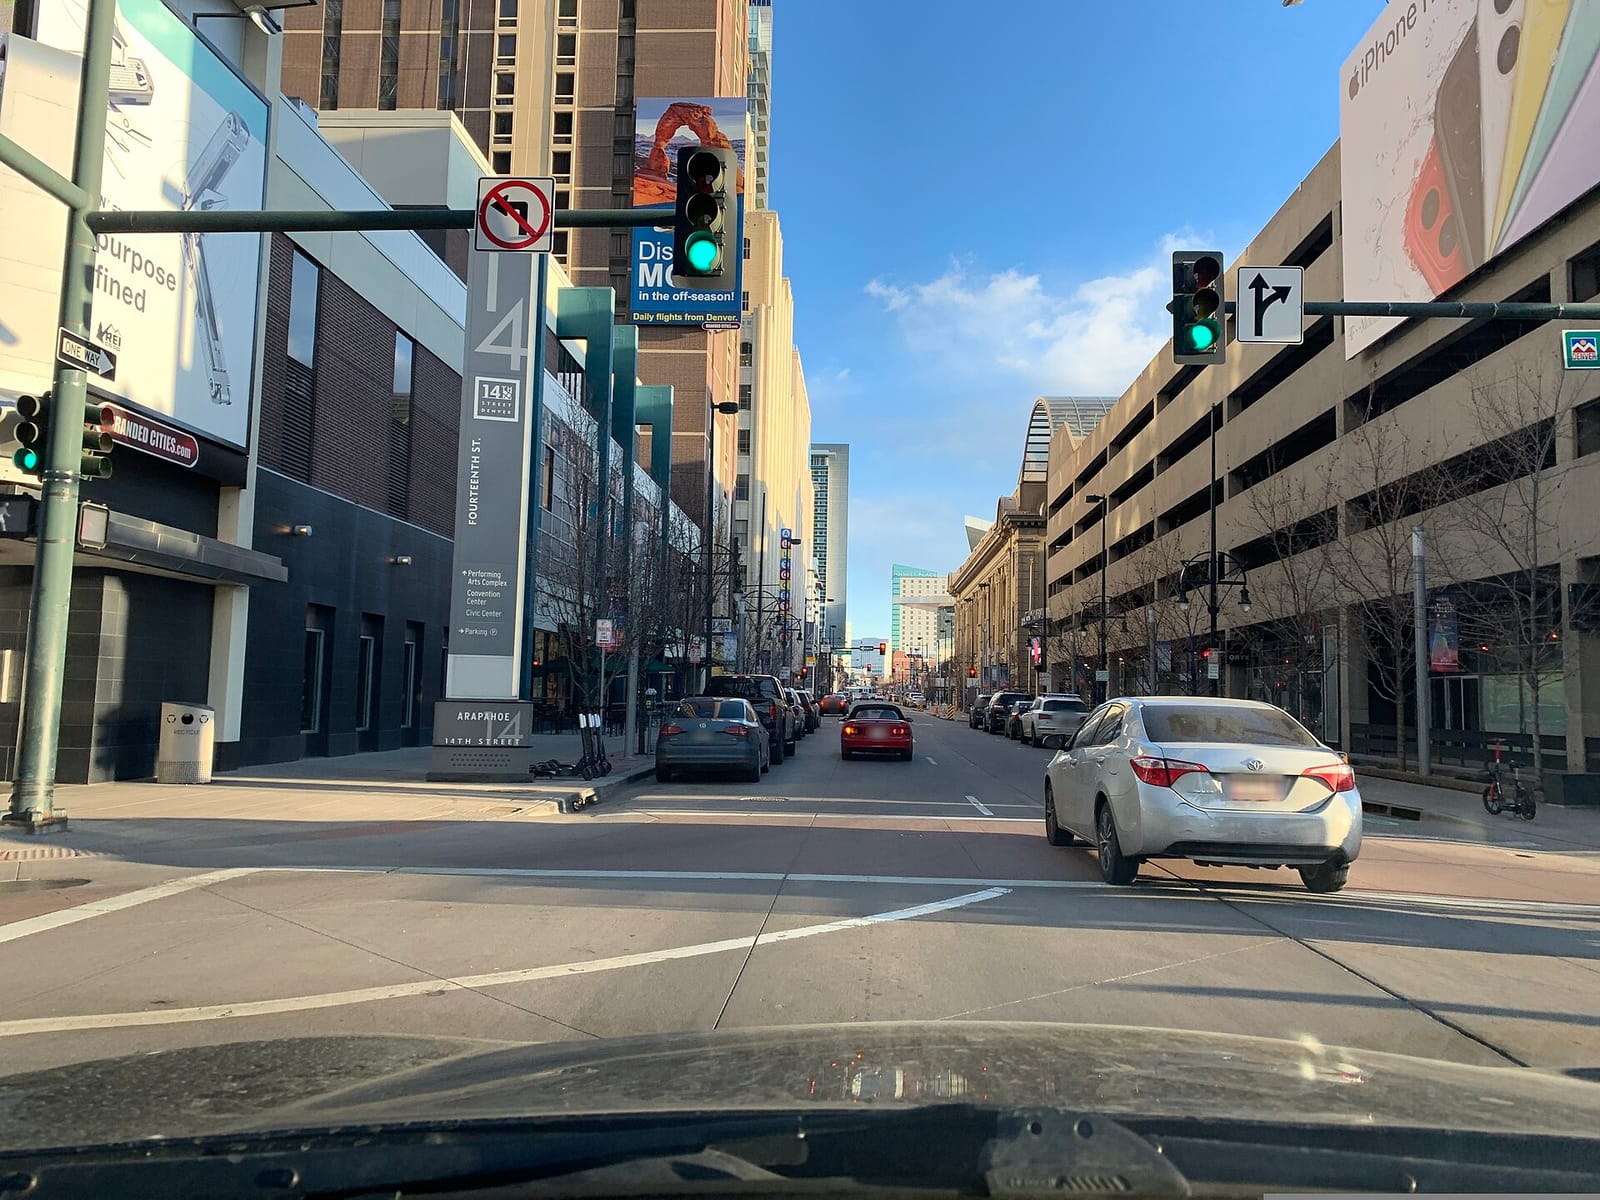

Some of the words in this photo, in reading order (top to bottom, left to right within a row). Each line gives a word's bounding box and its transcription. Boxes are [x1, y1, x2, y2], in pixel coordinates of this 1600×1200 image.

[1361, 3, 1417, 88] iPhone
[639, 291, 649, 301] in
[652, 291, 670, 301] the
[672, 291, 735, 301] off-season!
[633, 312, 655, 322] Daily
[656, 312, 682, 322] flights
[684, 312, 704, 321] from
[706, 313, 738, 321] Denver.
[105, 332, 121, 347] REI
[65, 340, 82, 358] ONE
[85, 350, 100, 366] WAY
[113, 415, 149, 443] RANDED
[150, 430, 192, 459] CITIES.com
[472, 437, 481, 453] ST.
[468, 456, 480, 525] FOURTEENTH
[468, 570, 502, 579] Performing
[467, 578, 480, 586] Arts
[481, 579, 507, 587] Complex
[466, 589, 500, 598] Convention
[466, 609, 480, 617] Civic
[481, 609, 502, 617] Center
[465, 628, 488, 637] Parking
[457, 711, 511, 721] ARAPAHOE
[445, 737, 471, 745] 14TH
[479, 738, 521, 746] STREET
